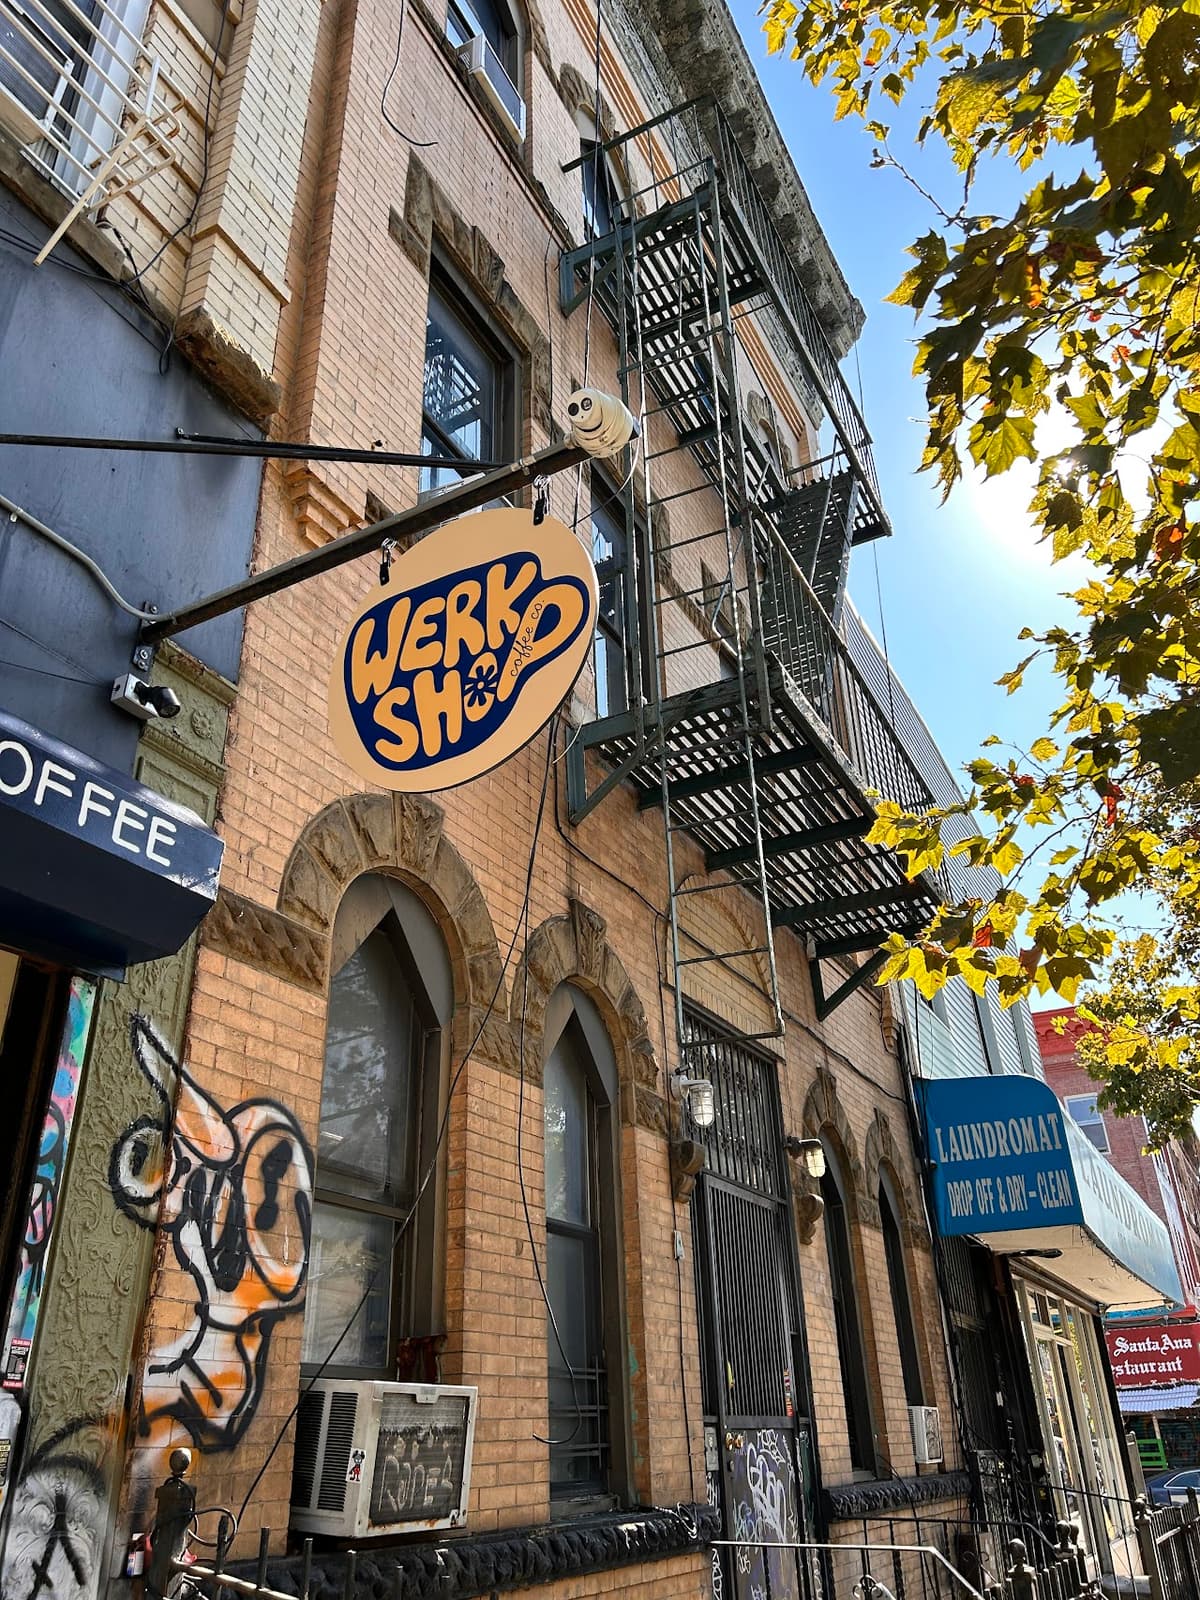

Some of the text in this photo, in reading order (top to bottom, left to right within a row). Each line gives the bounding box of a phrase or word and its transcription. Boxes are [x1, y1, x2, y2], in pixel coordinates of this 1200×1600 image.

[351, 561, 537, 704] WERK
[373, 583, 584, 762] SHOP
[510, 626, 533, 676] coffee
[0, 740, 177, 867] OFFEE
[935, 1113, 1062, 1163] LAUNDROMAT
[947, 1180, 973, 1217] DROP
[975, 1178, 994, 1215] OFF
[996, 1177, 1008, 1214] &
